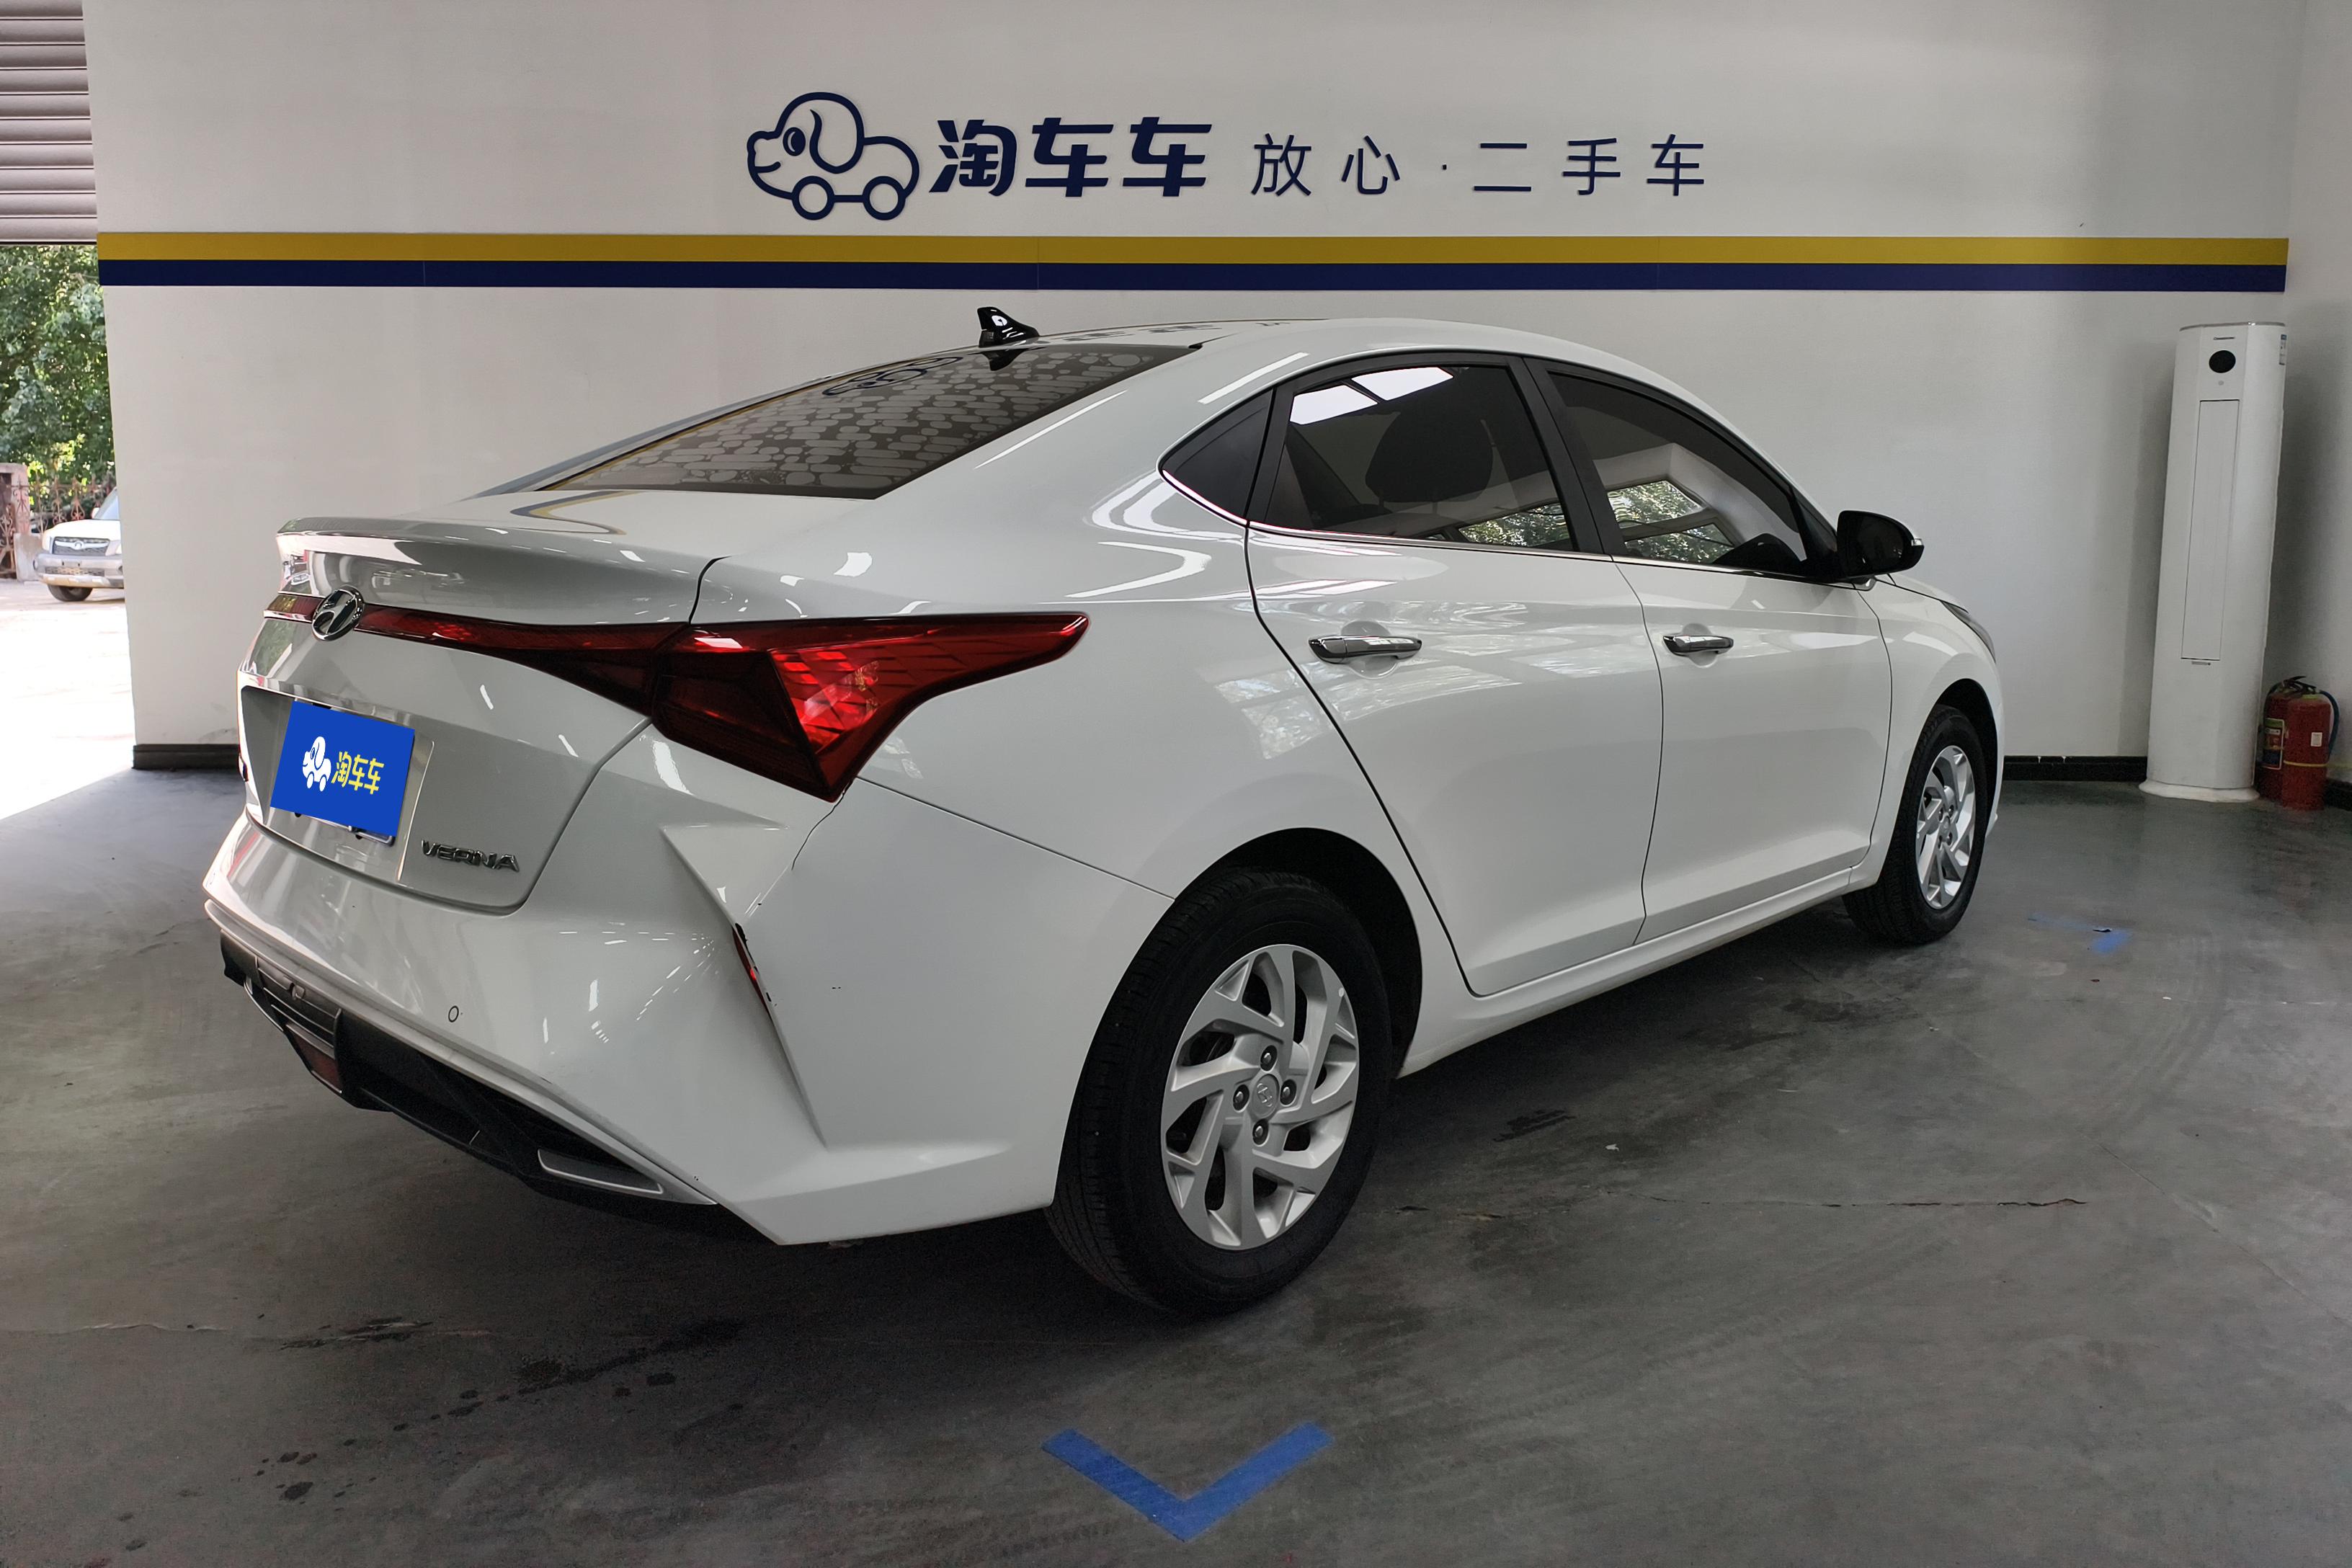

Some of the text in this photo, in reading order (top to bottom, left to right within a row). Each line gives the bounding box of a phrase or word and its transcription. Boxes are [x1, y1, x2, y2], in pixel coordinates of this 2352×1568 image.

[929, 117, 1212, 197] 淘车车
[421, 839, 520, 873] VERNA
